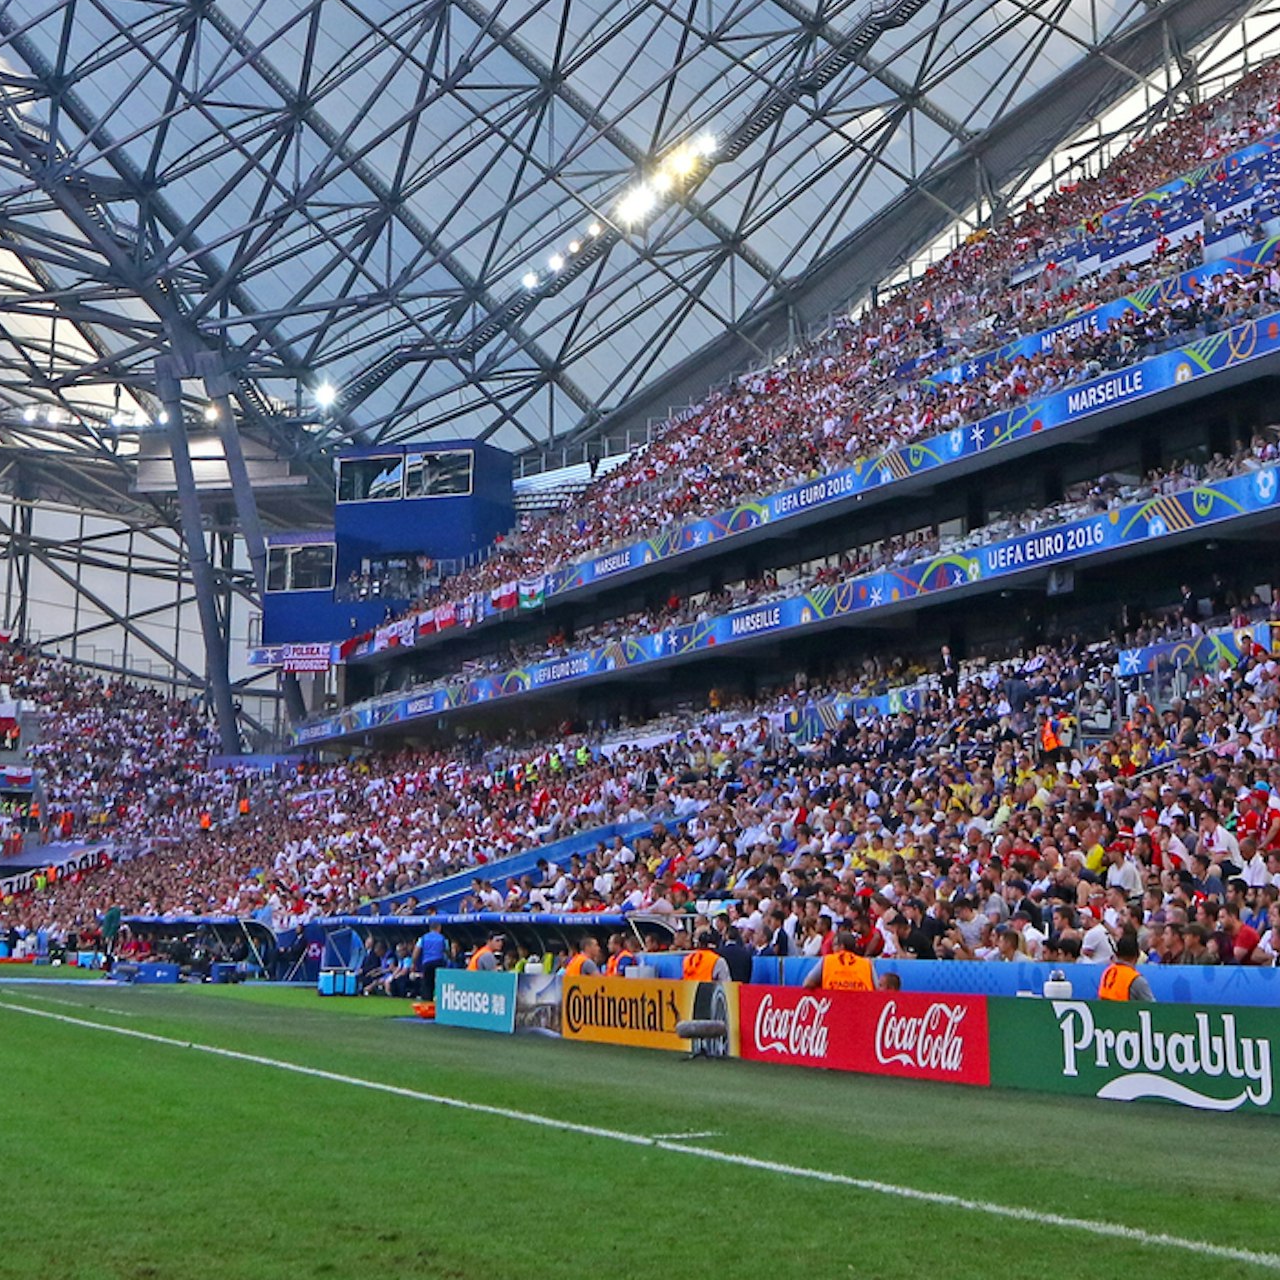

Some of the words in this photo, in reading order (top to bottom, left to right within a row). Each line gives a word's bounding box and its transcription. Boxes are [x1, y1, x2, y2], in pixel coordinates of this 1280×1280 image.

[1068, 370, 1143, 414] MARSEILLE
[774, 492, 800, 514] UEFA
[800, 483, 826, 506] EURO
[827, 473, 854, 497] 2016
[593, 551, 631, 577] MARSEILLE
[988, 543, 1024, 570] UEFA
[1025, 533, 1064, 561] EURO
[1066, 522, 1104, 552] 2016
[732, 607, 780, 636] MARSEILLE
[441, 982, 490, 1014] Hisense
[566, 985, 665, 1034] Continental
[754, 993, 832, 1058] Coca-Cola
[876, 1000, 968, 1071] Coca-Cola
[1052, 1001, 1272, 1106] Probably
